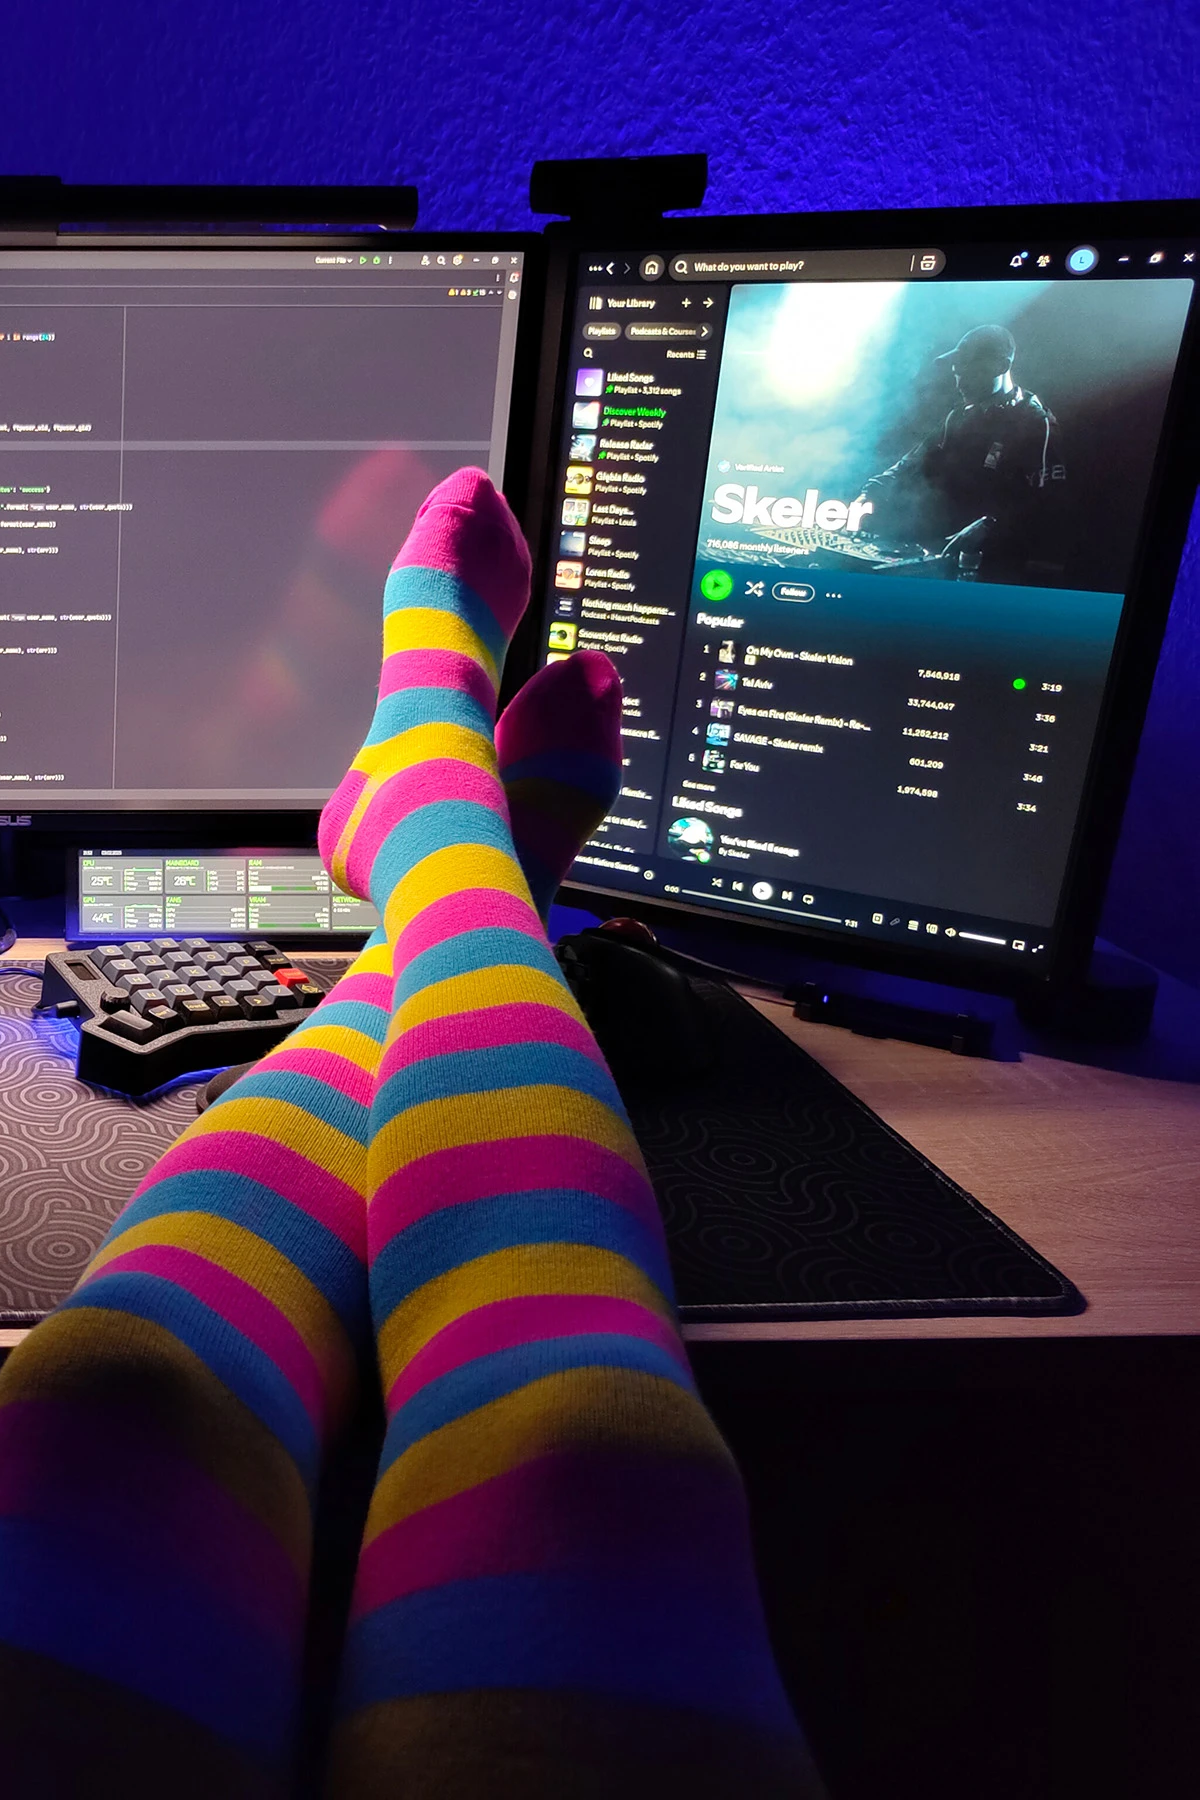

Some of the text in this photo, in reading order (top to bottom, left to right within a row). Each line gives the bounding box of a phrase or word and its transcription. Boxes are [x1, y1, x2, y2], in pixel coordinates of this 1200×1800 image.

[694, 260, 804, 273] What do you want to play?
[608, 298, 656, 309] Your Library
[588, 327, 616, 336] Playlists
[631, 327, 661, 336] Podcasts
[666, 350, 695, 359] Recents
[607, 372, 655, 384] Liked Songs
[614, 385, 638, 395] Playlist
[661, 388, 681, 396] songs
[604, 407, 666, 418] Discover Weekly
[600, 439, 654, 450] Release Radar
[711, 483, 873, 532] Skeler
[589, 535, 612, 547] Sleep
[740, 542, 772, 553] monthly
[774, 544, 810, 555] listeners
[697, 612, 744, 628] Popular
[746, 646, 854, 666] On My Own Skeler Vision
[742, 678, 773, 690] Tel Aviv
[1041, 682, 1062, 692] 3:19
[1029, 743, 1049, 753] 3:21
[730, 760, 760, 773] For You
[909, 757, 944, 769] 601,209
[1017, 802, 1037, 813] 3:34
